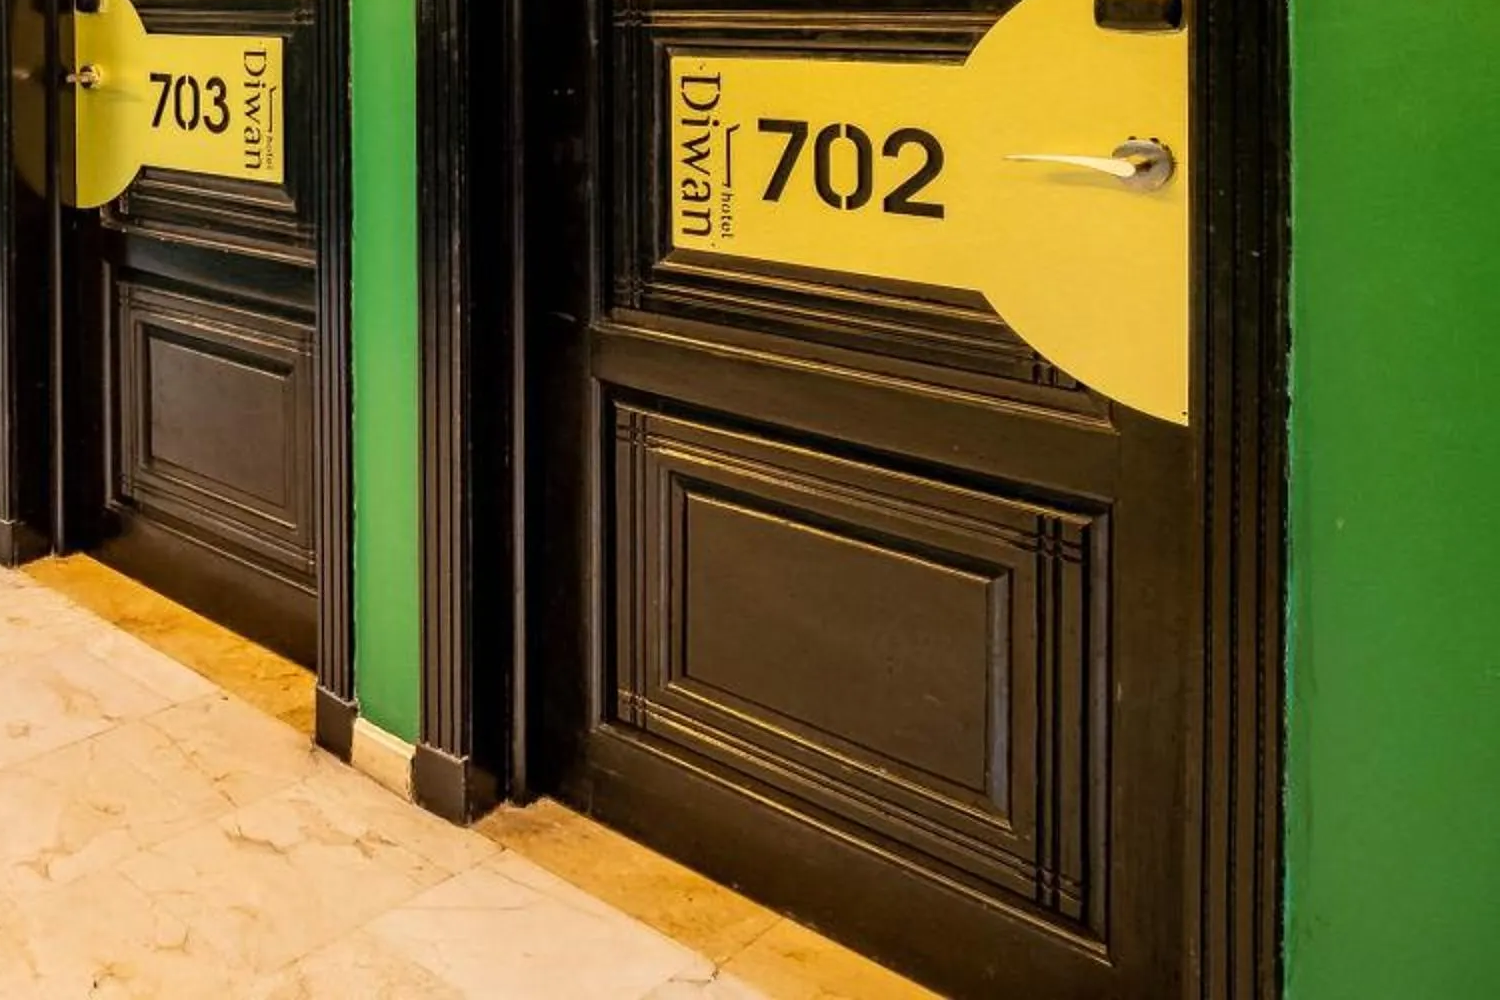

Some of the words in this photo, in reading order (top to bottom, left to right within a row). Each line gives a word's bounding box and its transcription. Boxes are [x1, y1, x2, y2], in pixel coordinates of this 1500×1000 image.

[149, 72, 230, 135] 703
[243, 50, 267, 170] Diwan
[681, 72, 721, 238] Diwan
[721, 191, 735, 239] hotel
[757, 117, 945, 220] 702
